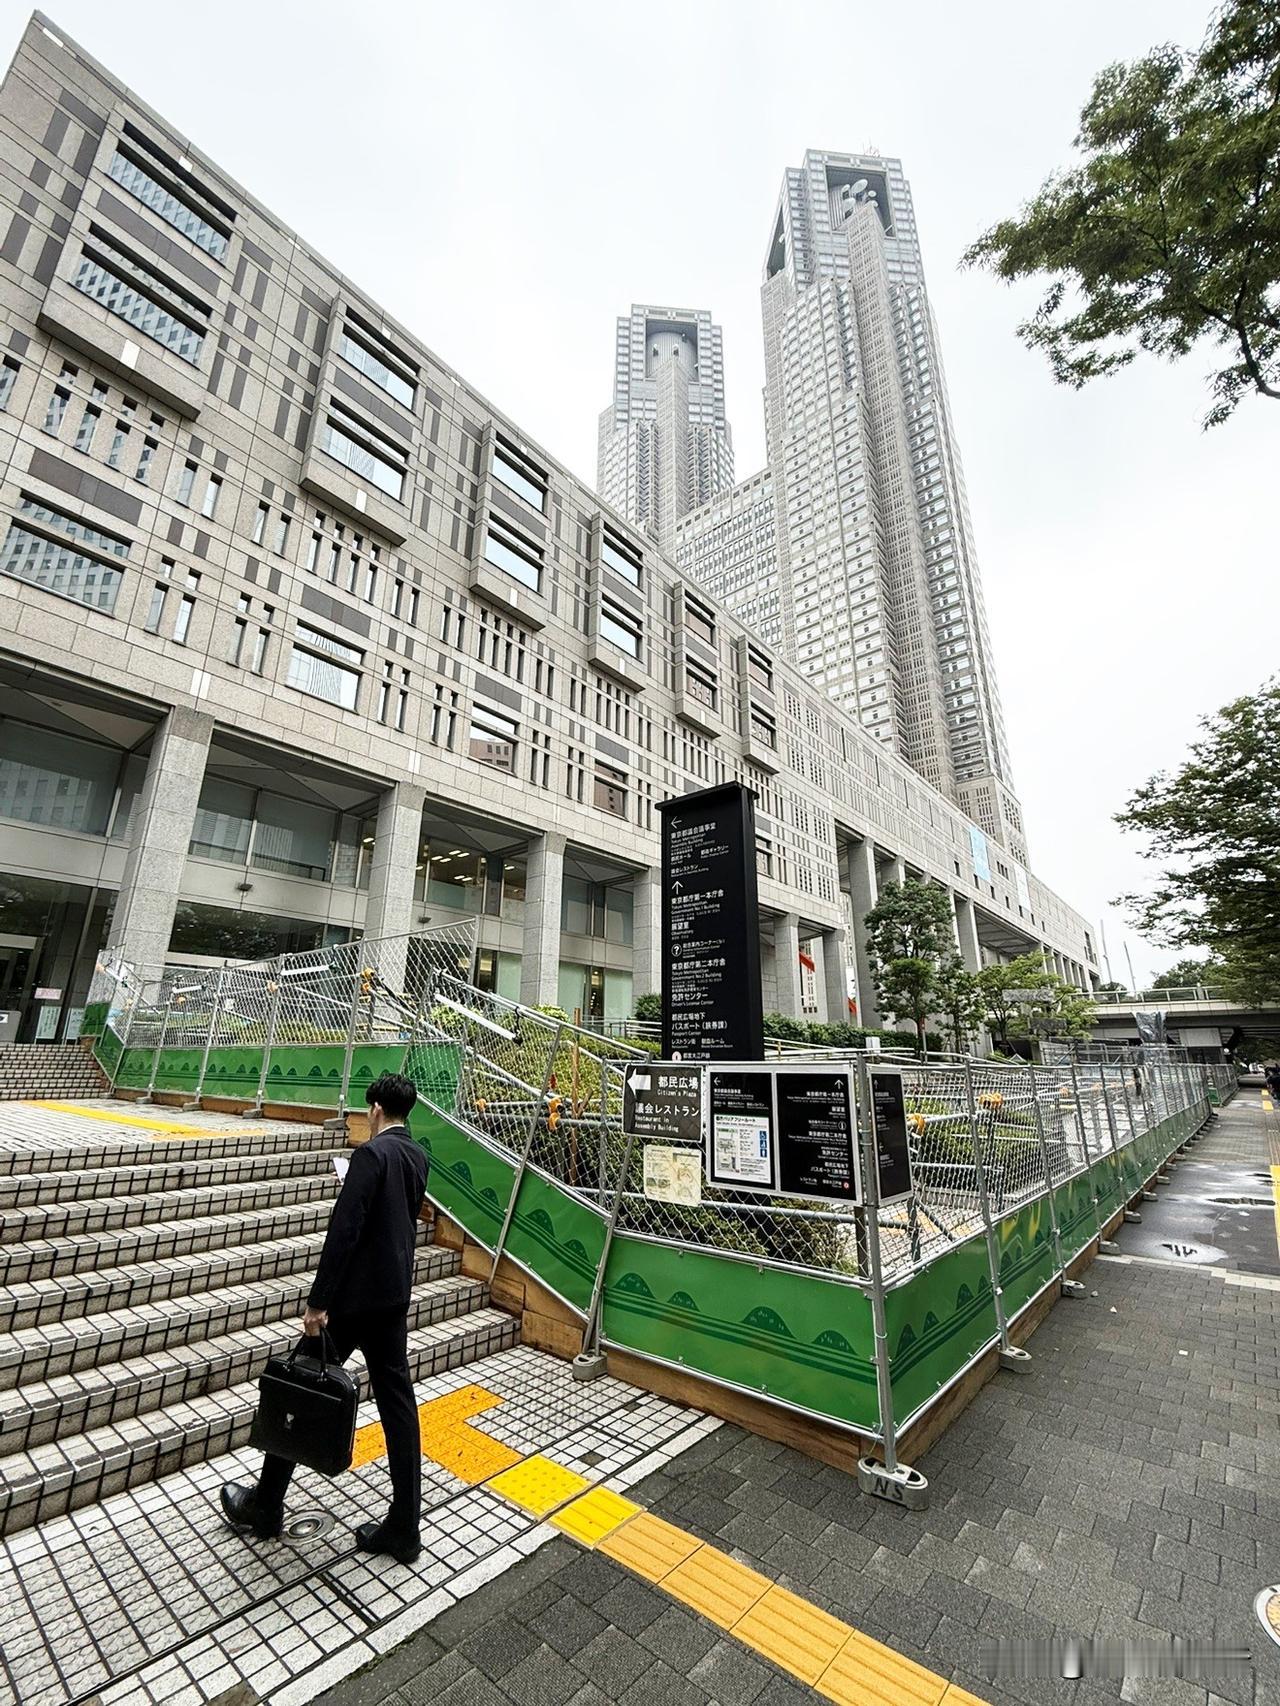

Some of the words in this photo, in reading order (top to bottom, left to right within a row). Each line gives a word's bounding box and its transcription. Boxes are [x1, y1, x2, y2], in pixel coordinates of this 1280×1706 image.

[658, 1075, 699, 1090] 都民広場
[657, 1089, 681, 1097] Citizen's
[682, 1090, 697, 1098] Plaza
[634, 1102, 700, 1117] 議会レストラン
[634, 1114, 662, 1123] Restaurant
[634, 1121, 657, 1131] Assembly
[657, 1124, 679, 1133] Building
